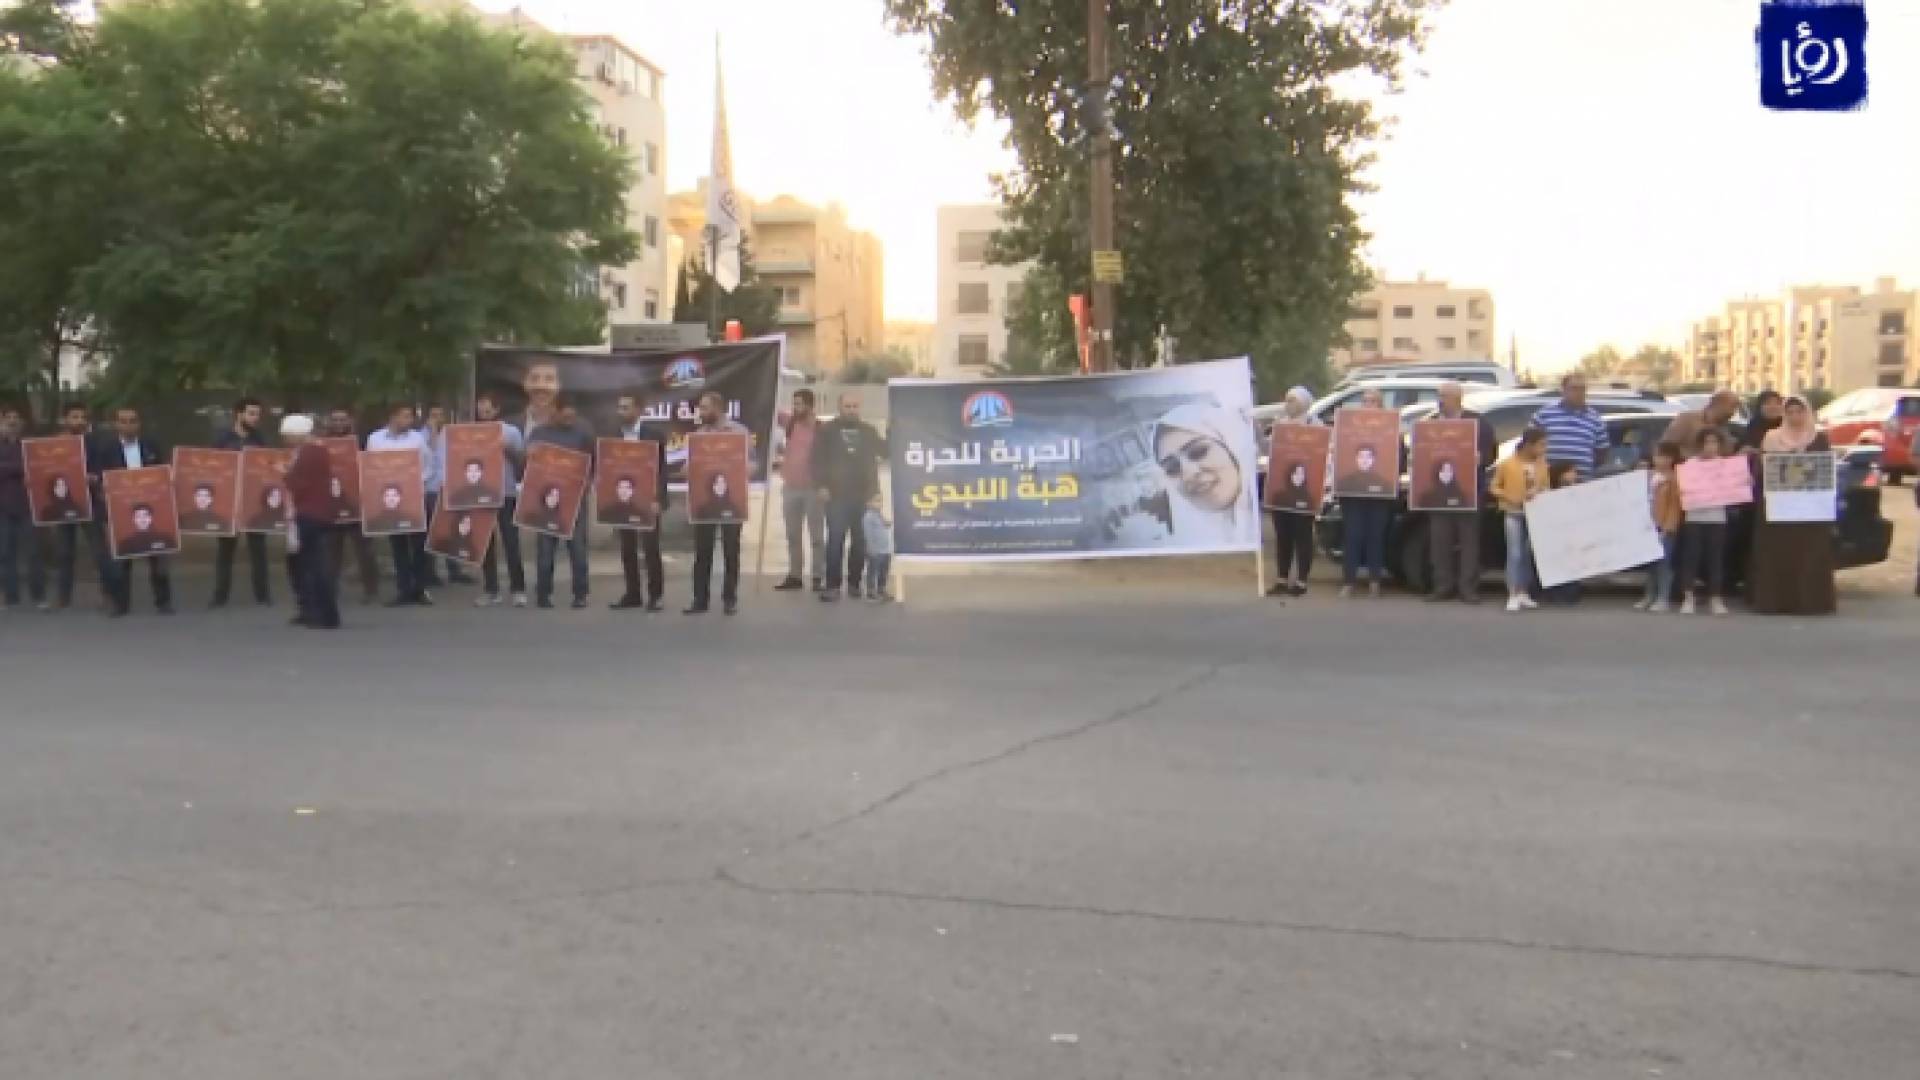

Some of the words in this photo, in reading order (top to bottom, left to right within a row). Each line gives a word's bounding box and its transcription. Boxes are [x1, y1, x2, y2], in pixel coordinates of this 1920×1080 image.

[905, 440, 980, 472] للحرة
[991, 437, 1080, 470] الحرية
[910, 476, 1008, 516] اللبدي
[1018, 473, 1078, 507] هبة
